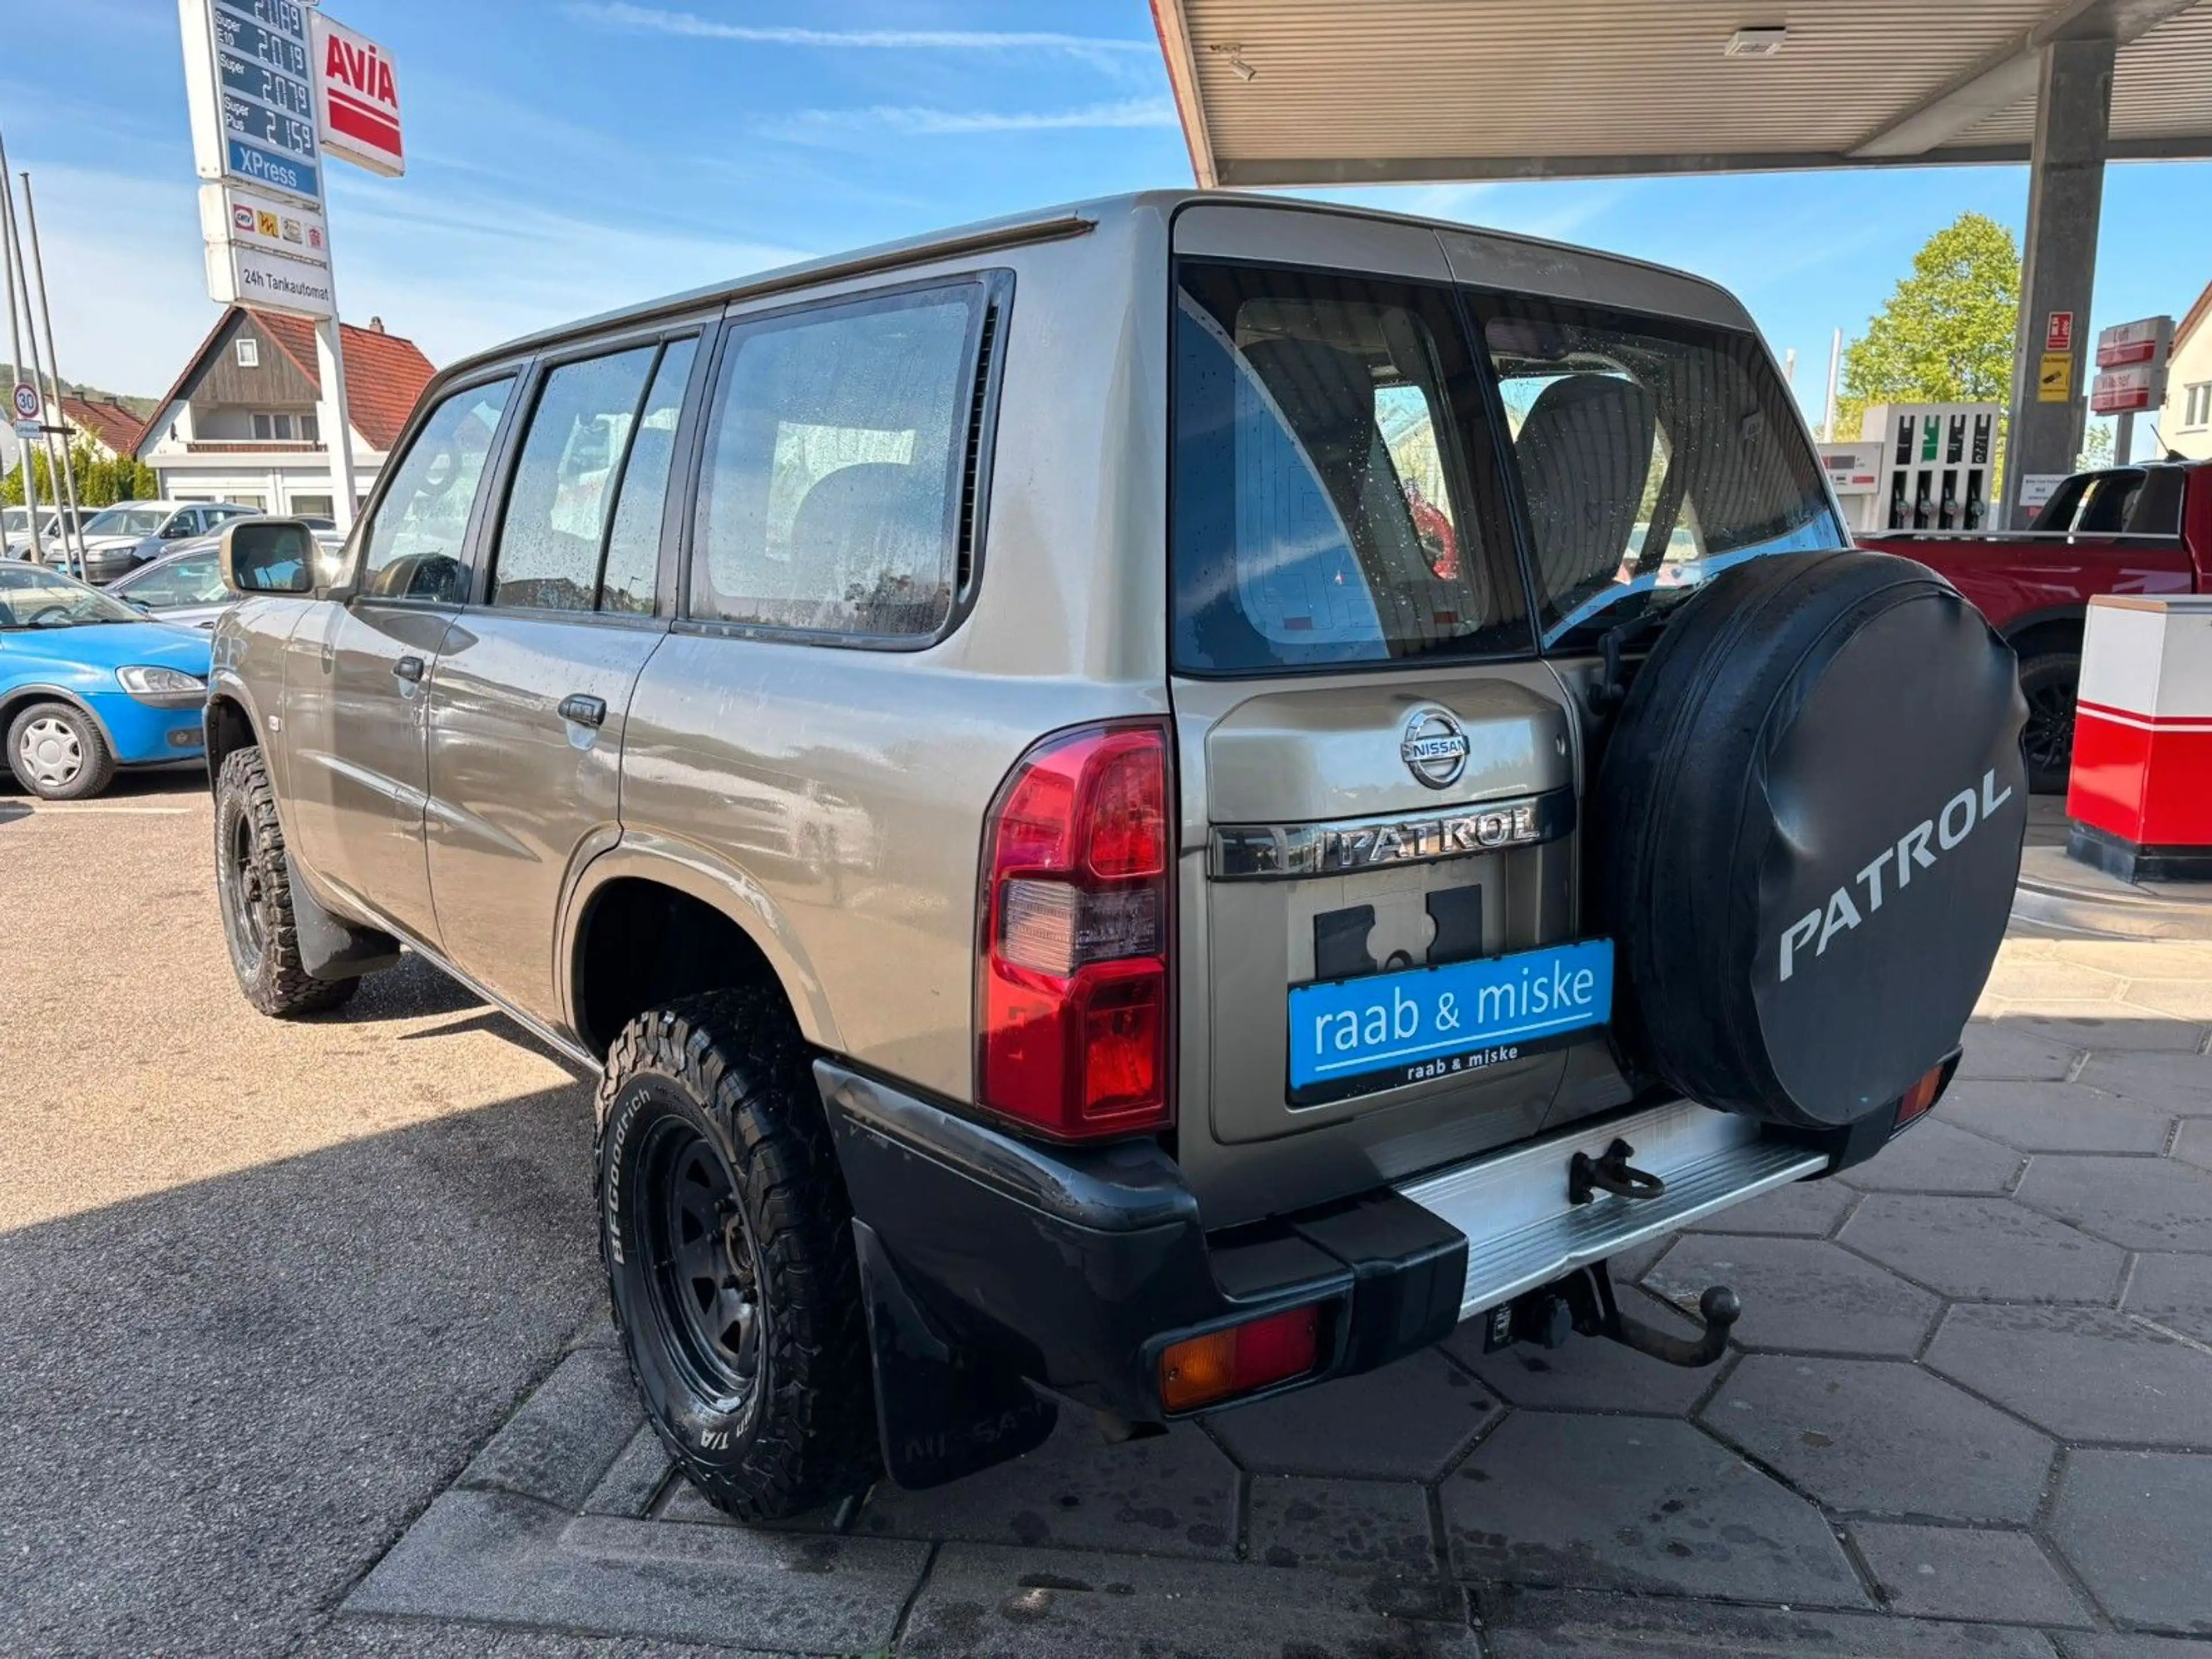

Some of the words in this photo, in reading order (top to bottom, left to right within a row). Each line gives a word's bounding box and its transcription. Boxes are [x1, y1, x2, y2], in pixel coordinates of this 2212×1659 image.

[220, 54, 245, 75] Super
[224, 96, 249, 116] Super
[225, 113, 245, 131] Plus
[240, 146, 297, 187] XPress
[244, 268, 264, 287] 24h
[266, 273, 329, 301] Tankautomat
[18, 393, 34, 409] 30
[1413, 738, 1467, 756] NISSAN
[1339, 808, 1540, 865] PATROL
[1781, 768, 2012, 982] PATROL
[1315, 986, 1419, 1054] raab
[1435, 991, 1459, 1031] &
[1478, 960, 1594, 1024] miske
[1407, 1059, 1446, 1081] raab
[1451, 1057, 1462, 1071] &
[1469, 1045, 1518, 1068] miske
[608, 1086, 652, 1265] BFGoodrich
